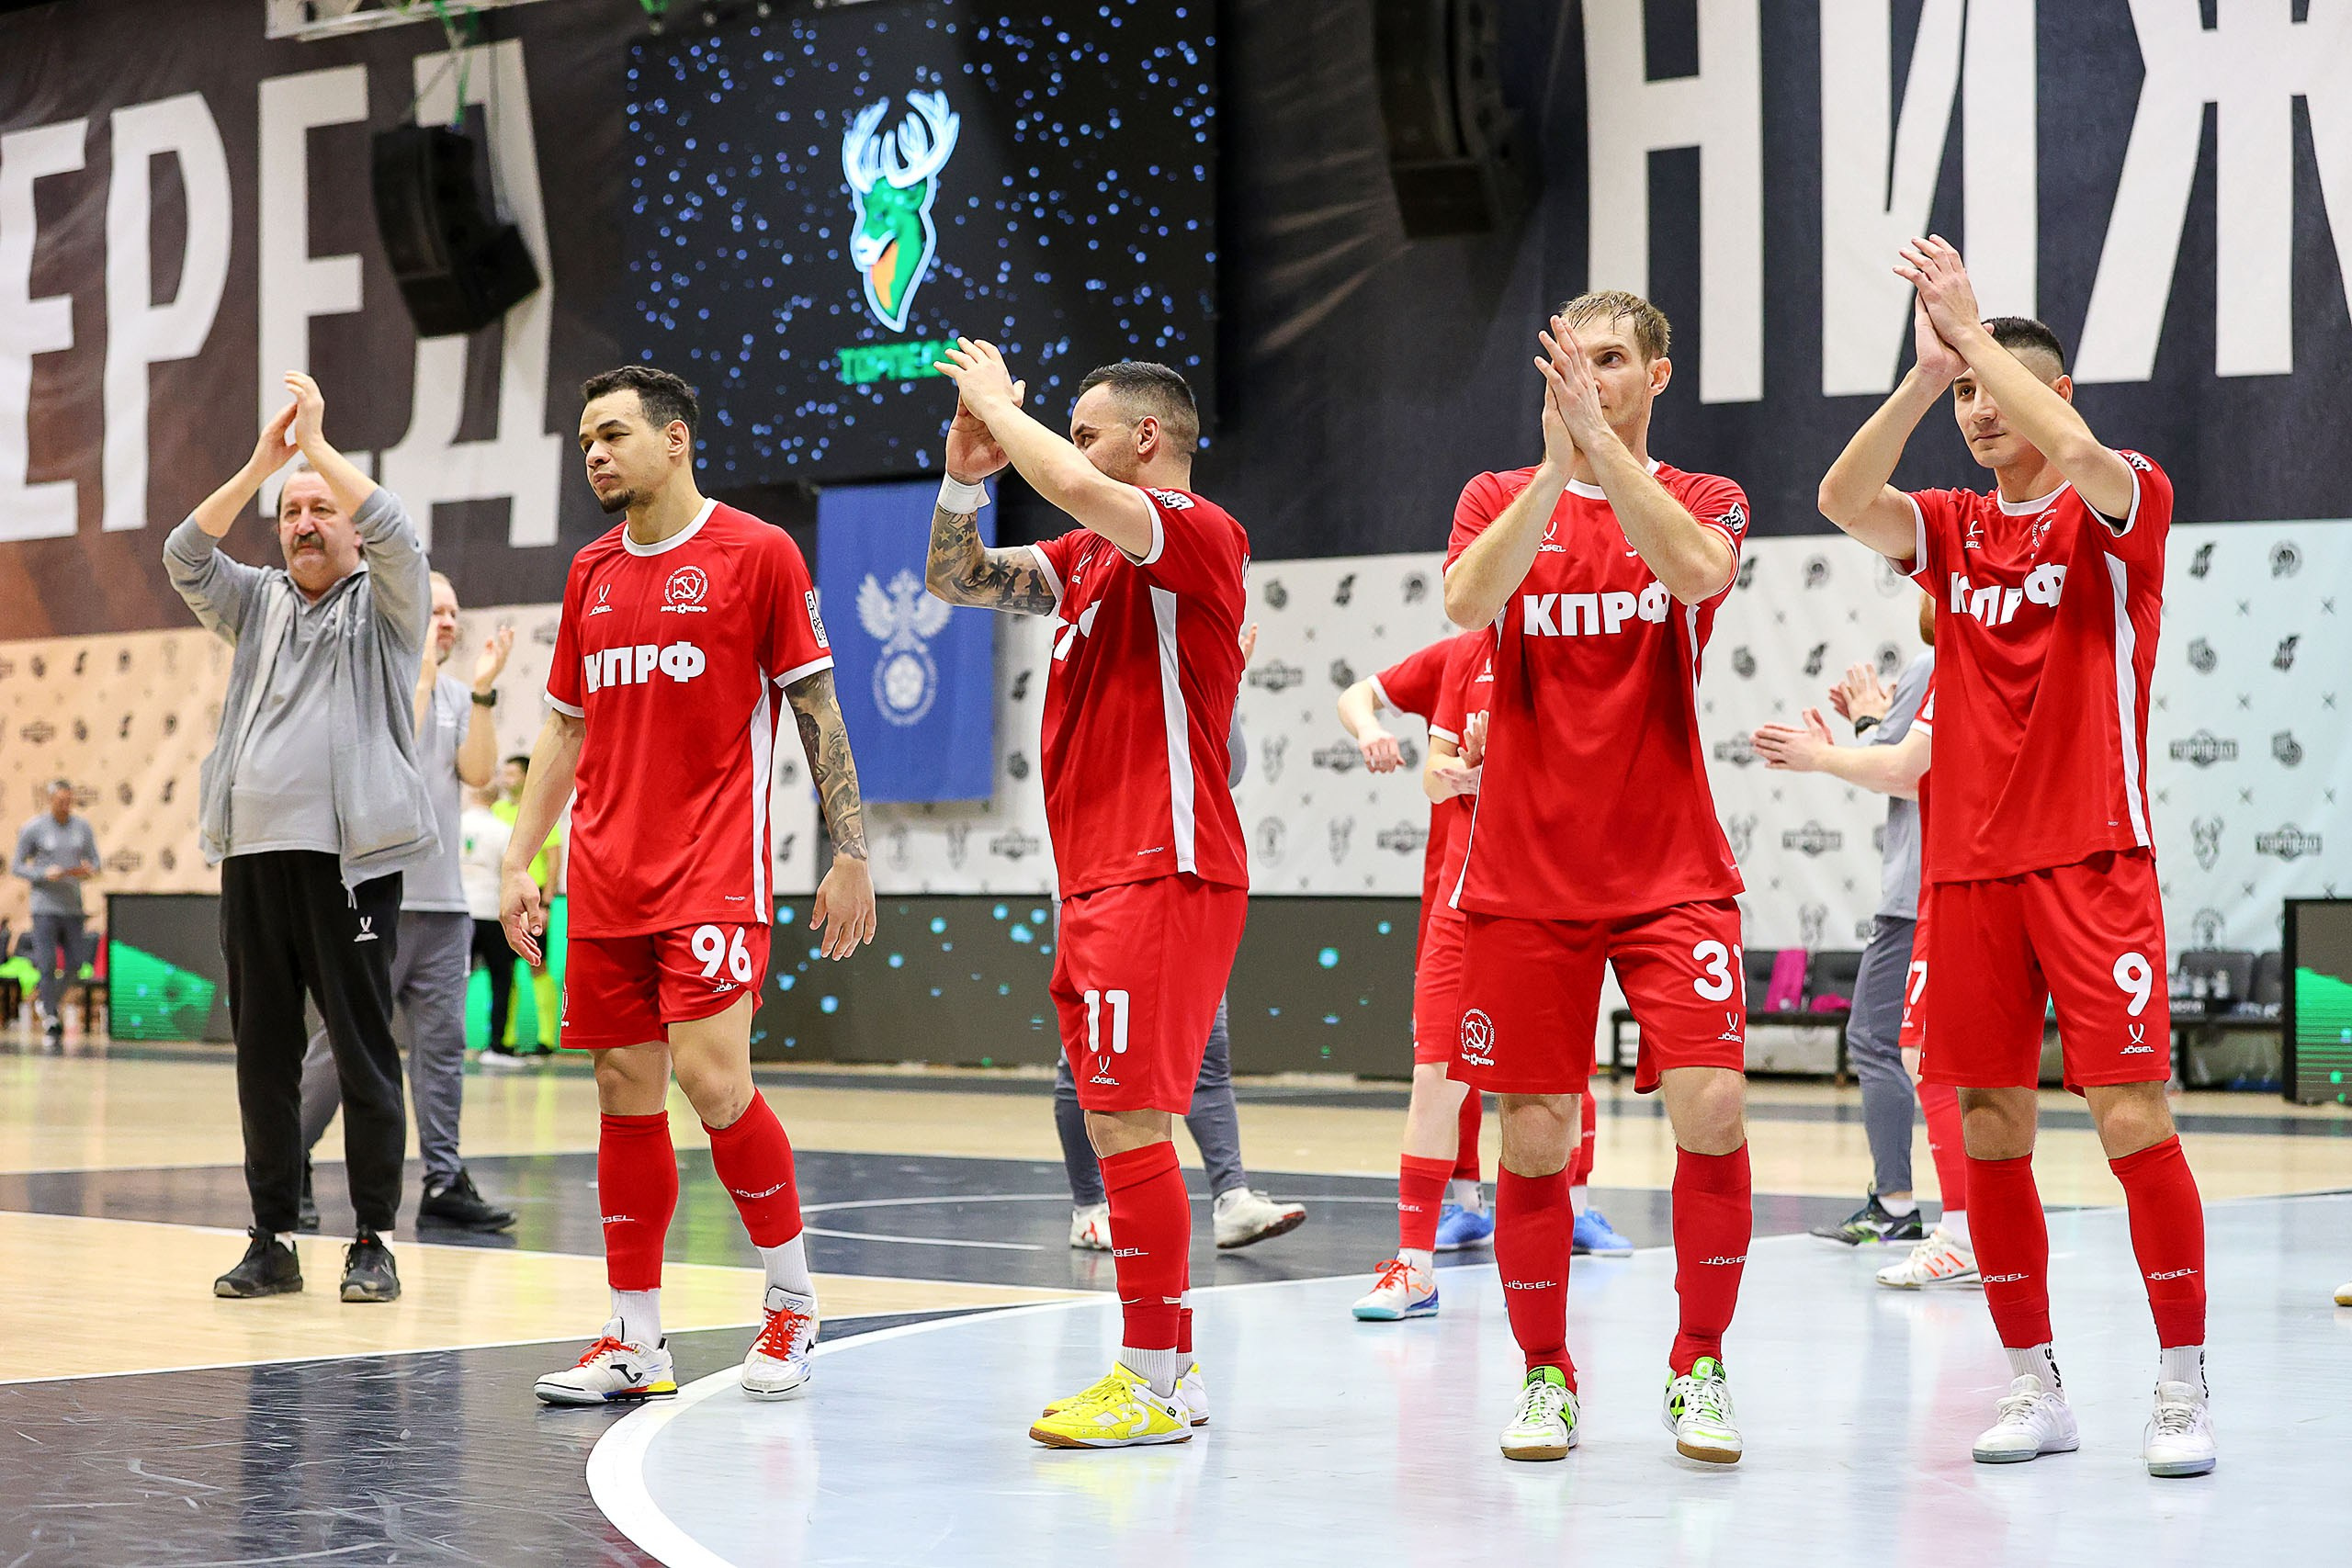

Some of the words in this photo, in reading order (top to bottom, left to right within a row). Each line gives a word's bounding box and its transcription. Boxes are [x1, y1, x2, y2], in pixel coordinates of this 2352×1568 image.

[1537, 543, 1566, 552] ÖGEL
[1951, 561, 2068, 627] КПРФ
[1522, 581, 1671, 637] КПРФ
[583, 640, 706, 694] КПРФ
[691, 924, 752, 982] 96
[2112, 952, 2154, 1017] 9
[1083, 989, 1129, 1054] 11
[2120, 1044, 2154, 1054] JÖGEL
[1089, 1076, 1120, 1087] JÖGEL
[730, 1181, 787, 1199] JÖGEL
[601, 1214, 636, 1224] GEL
[1112, 1247, 1149, 1258] GEL
[1699, 1255, 1747, 1266] JÖGE
[1981, 1273, 2030, 1284] JÖGEL
[2146, 1268, 2199, 1280] JÖGEL
[1504, 1280, 1557, 1290] JÖGEL
